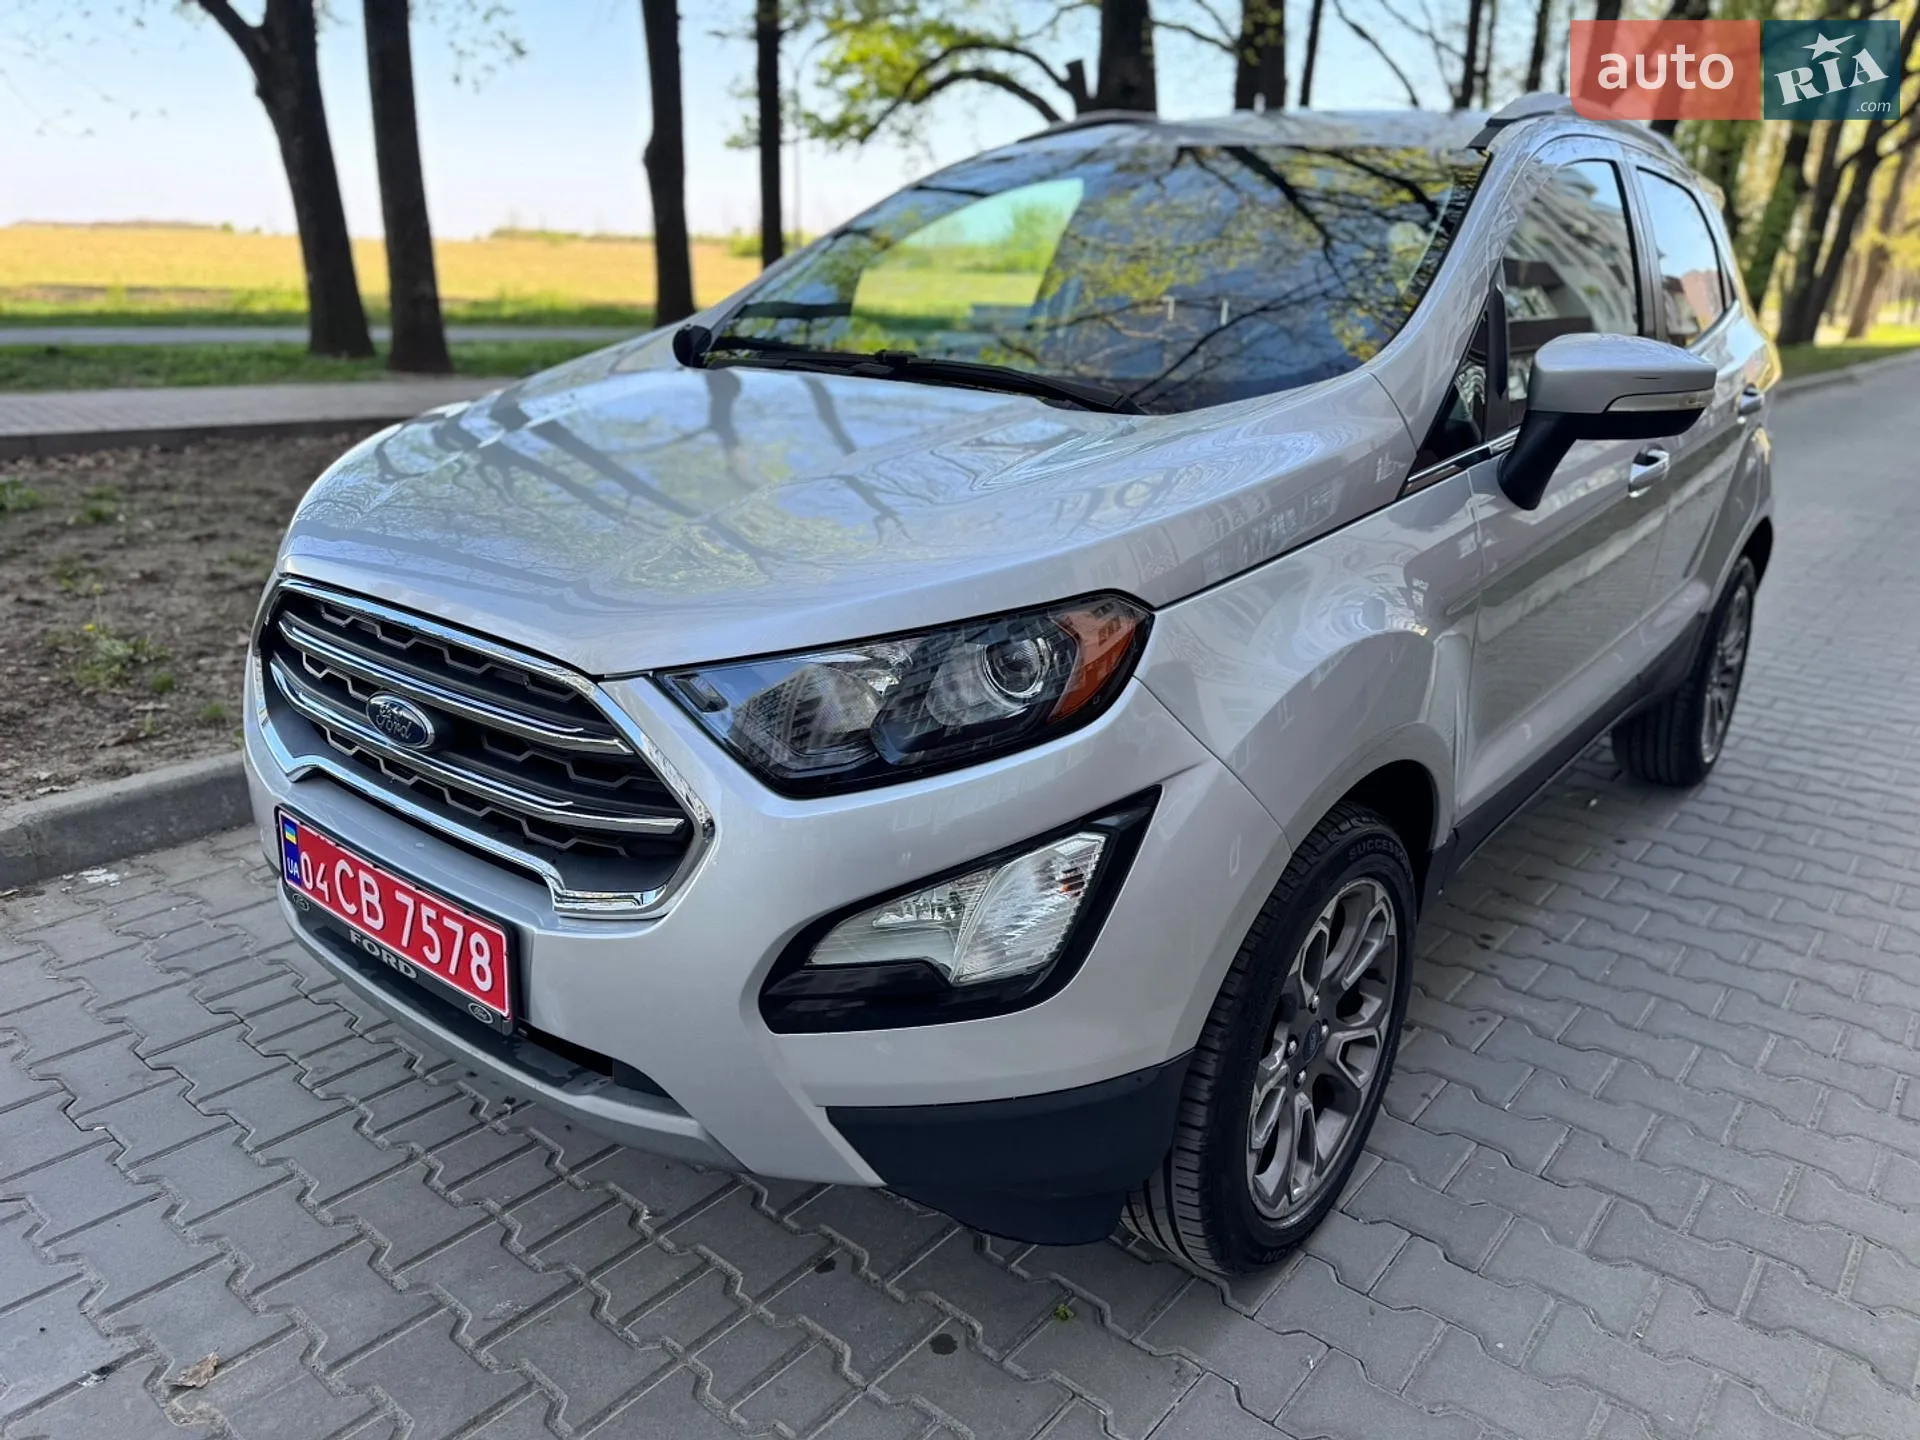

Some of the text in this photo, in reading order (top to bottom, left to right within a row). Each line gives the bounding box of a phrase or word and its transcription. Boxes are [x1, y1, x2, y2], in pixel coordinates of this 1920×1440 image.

[286, 856, 300, 879] UA
[350, 930, 417, 979] FORD
[395, 889, 493, 992] 7578
